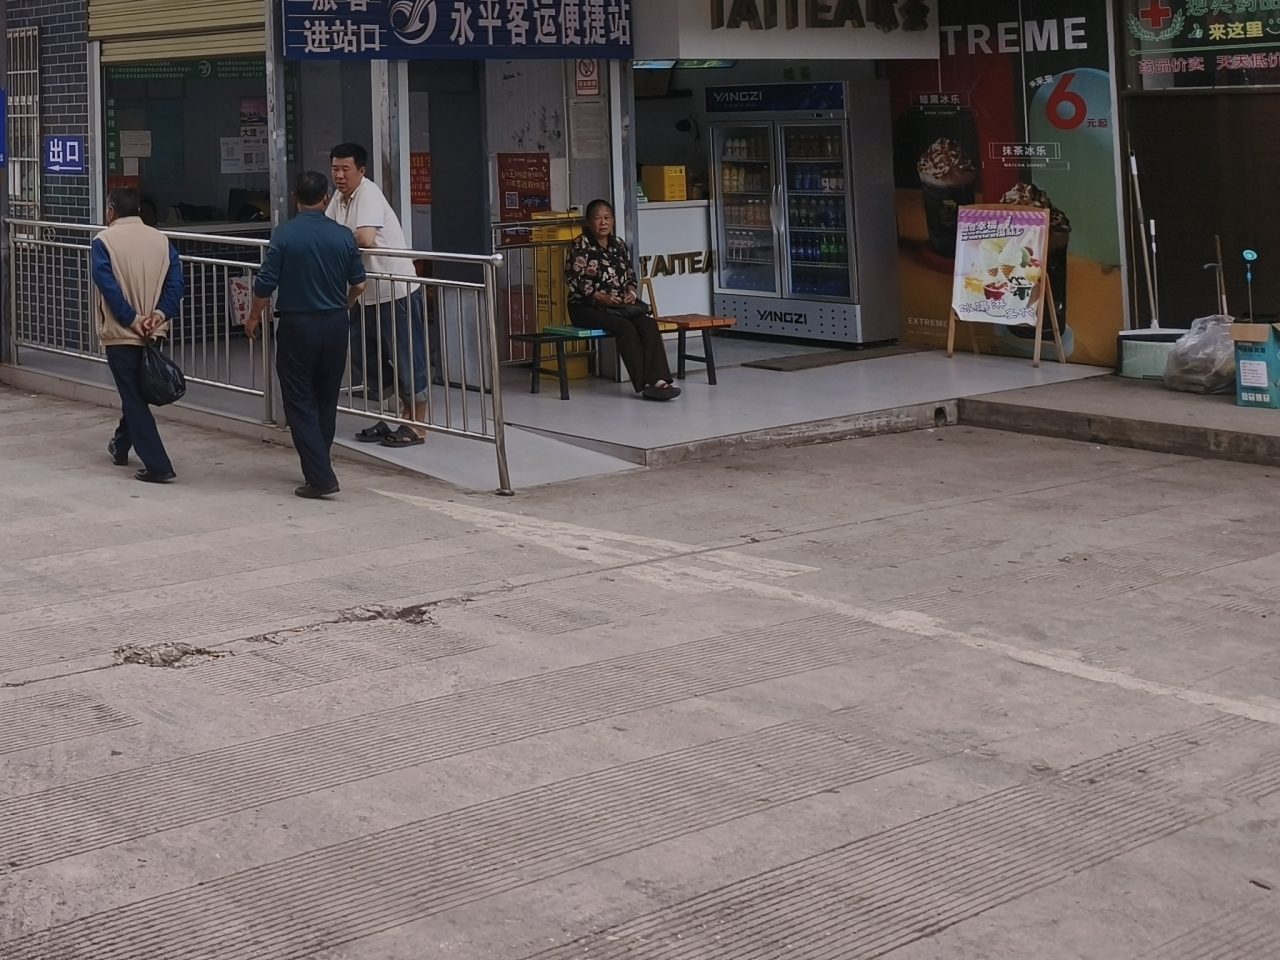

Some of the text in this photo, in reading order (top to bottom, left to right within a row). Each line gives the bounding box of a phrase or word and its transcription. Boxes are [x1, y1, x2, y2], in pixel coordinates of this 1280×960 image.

[303, 20, 381, 54] 进站口
[1208, 21, 1264, 40] 来这里
[1138, 56, 1205, 75] 药品价实
[713, 91, 763, 102] YANGZI
[1045, 72, 1088, 130] 6
[49, 138, 79, 164] 出口
[1002, 145, 1047, 156] 抹茶冰乐
[756, 309, 807, 325] YANGZI
